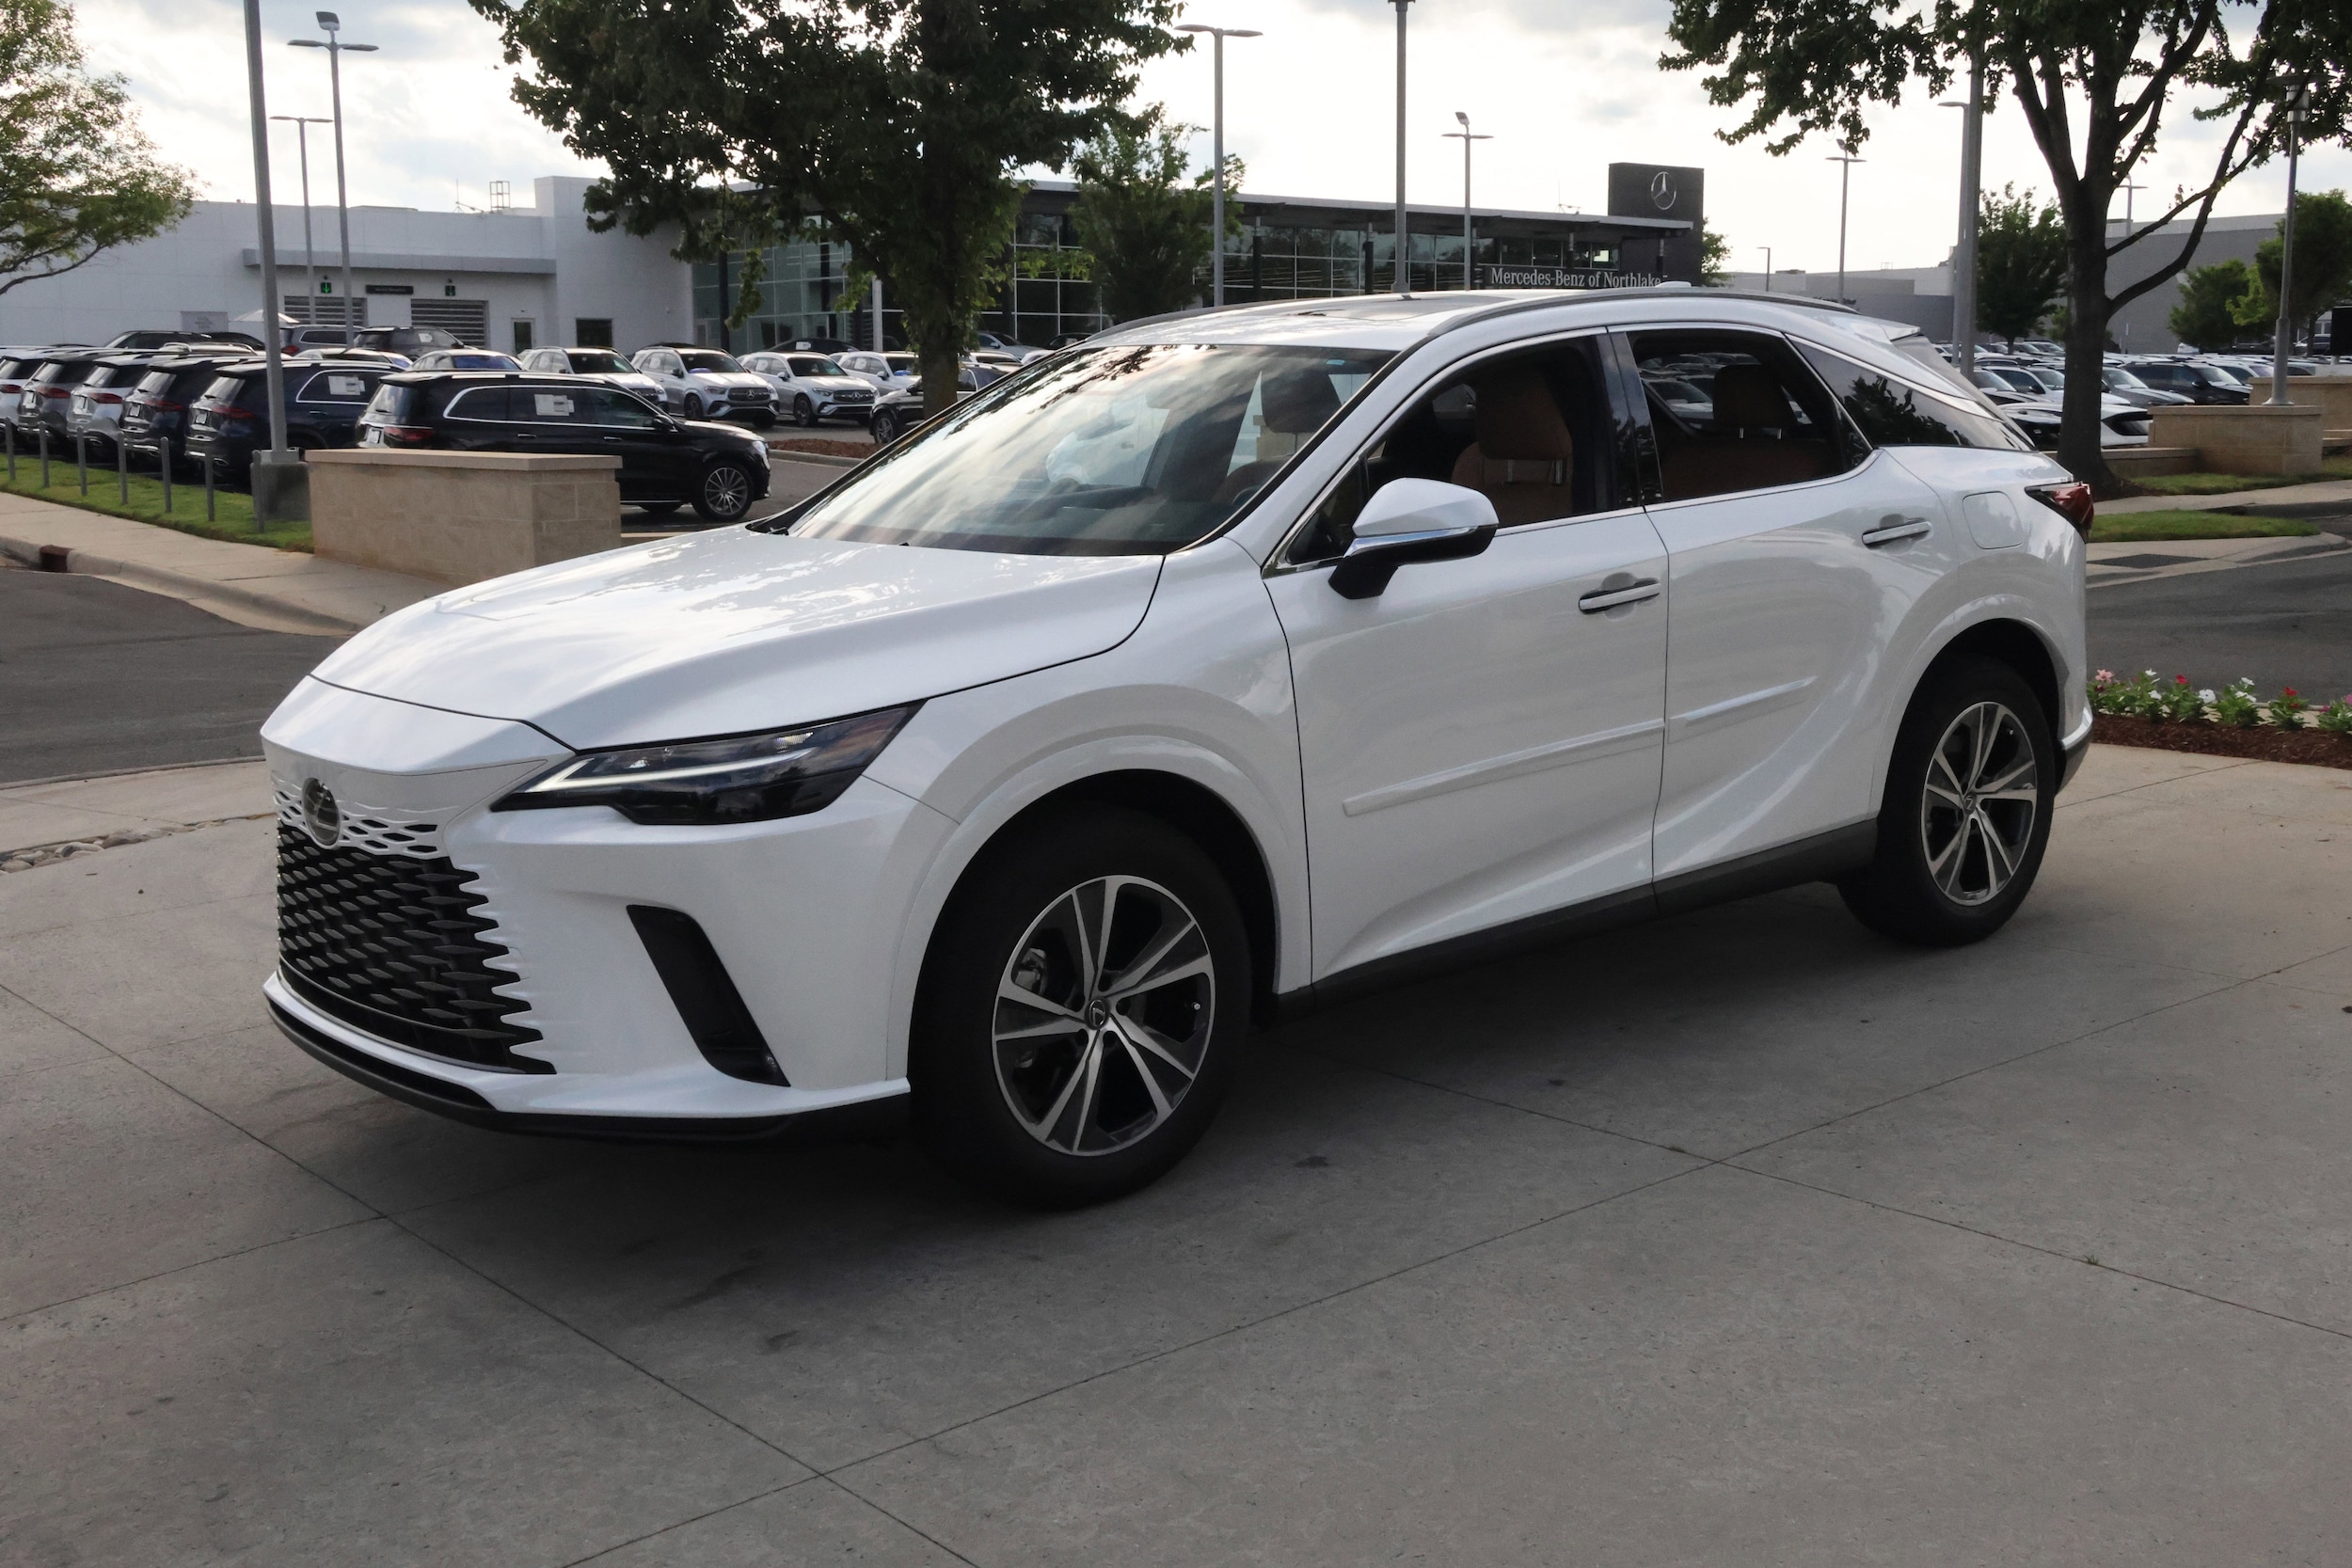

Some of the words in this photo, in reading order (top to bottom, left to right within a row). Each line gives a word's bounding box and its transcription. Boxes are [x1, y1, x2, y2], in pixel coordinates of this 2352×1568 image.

[1491, 267, 1585, 287] Mercedes-Benz
[1588, 271, 1602, 288] of
[1603, 272, 1661, 288] Northlake
